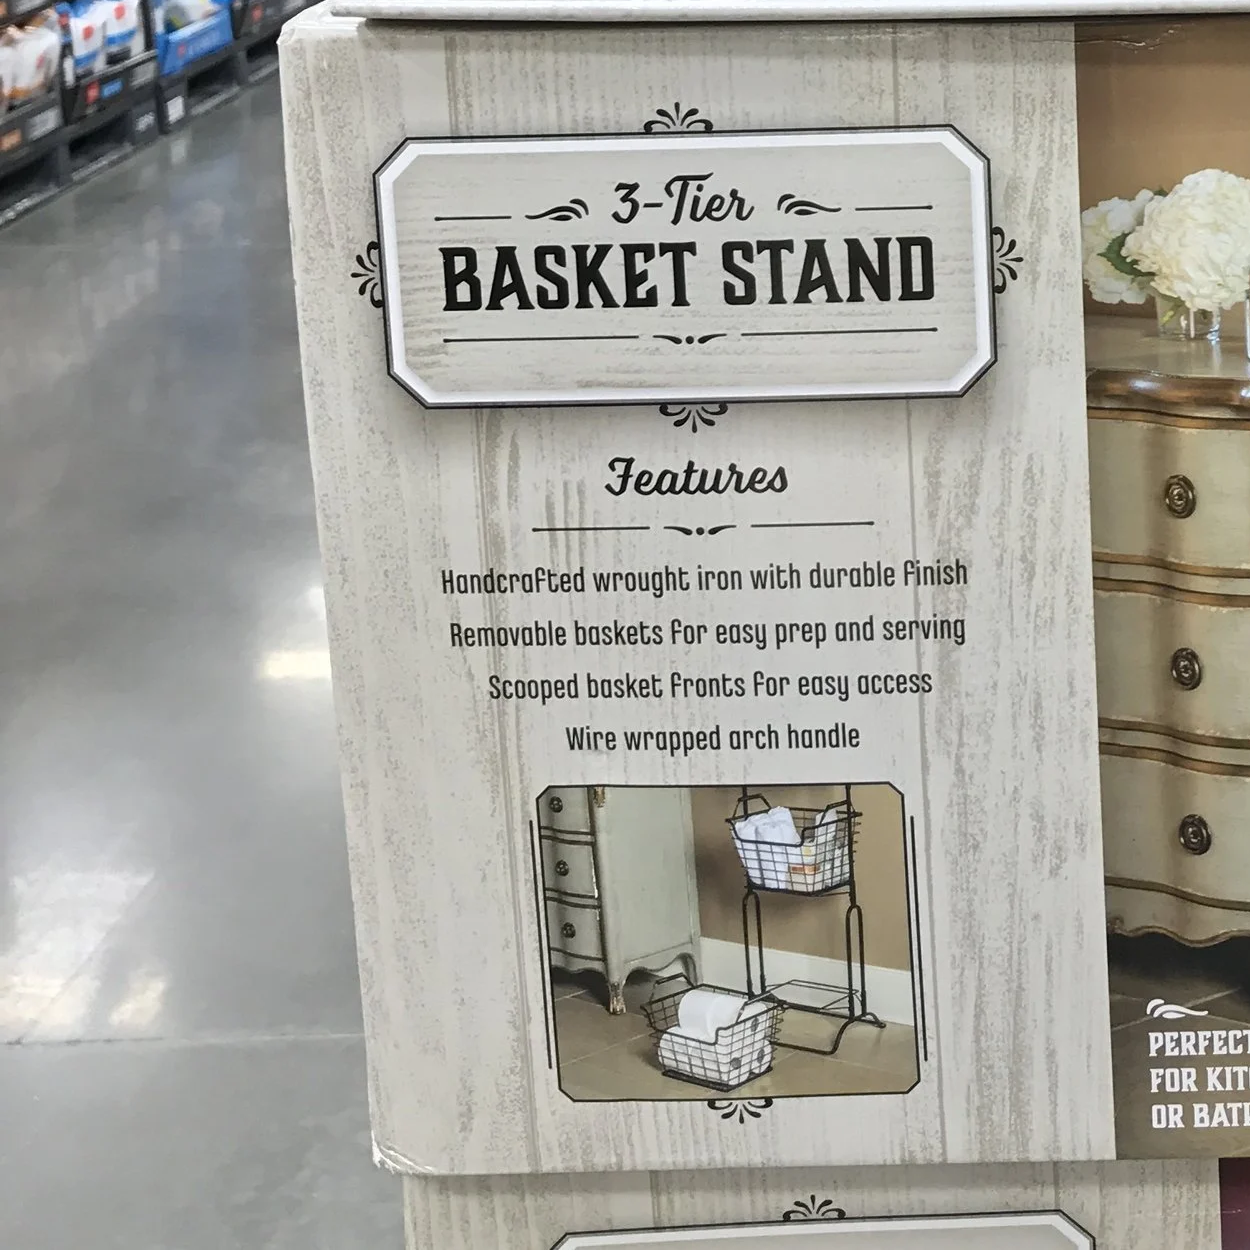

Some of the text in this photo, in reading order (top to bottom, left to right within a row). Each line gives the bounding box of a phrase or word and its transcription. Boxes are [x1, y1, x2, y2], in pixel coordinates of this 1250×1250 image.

[611, 172, 755, 226] 3-Tier
[438, 235, 935, 312] BASKET STAND
[604, 456, 789, 497] Features
[441, 558, 968, 599] Handcrafted wrought iron with durable finish
[449, 612, 966, 651] Removable baskets for easy prep and serving
[488, 670, 933, 706] Scooped basket fronts for easy access
[565, 722, 861, 758] Wire wrapped arch handle
[1150, 1067, 1198, 1092] FOR
[1152, 1104, 1184, 1128] OR
